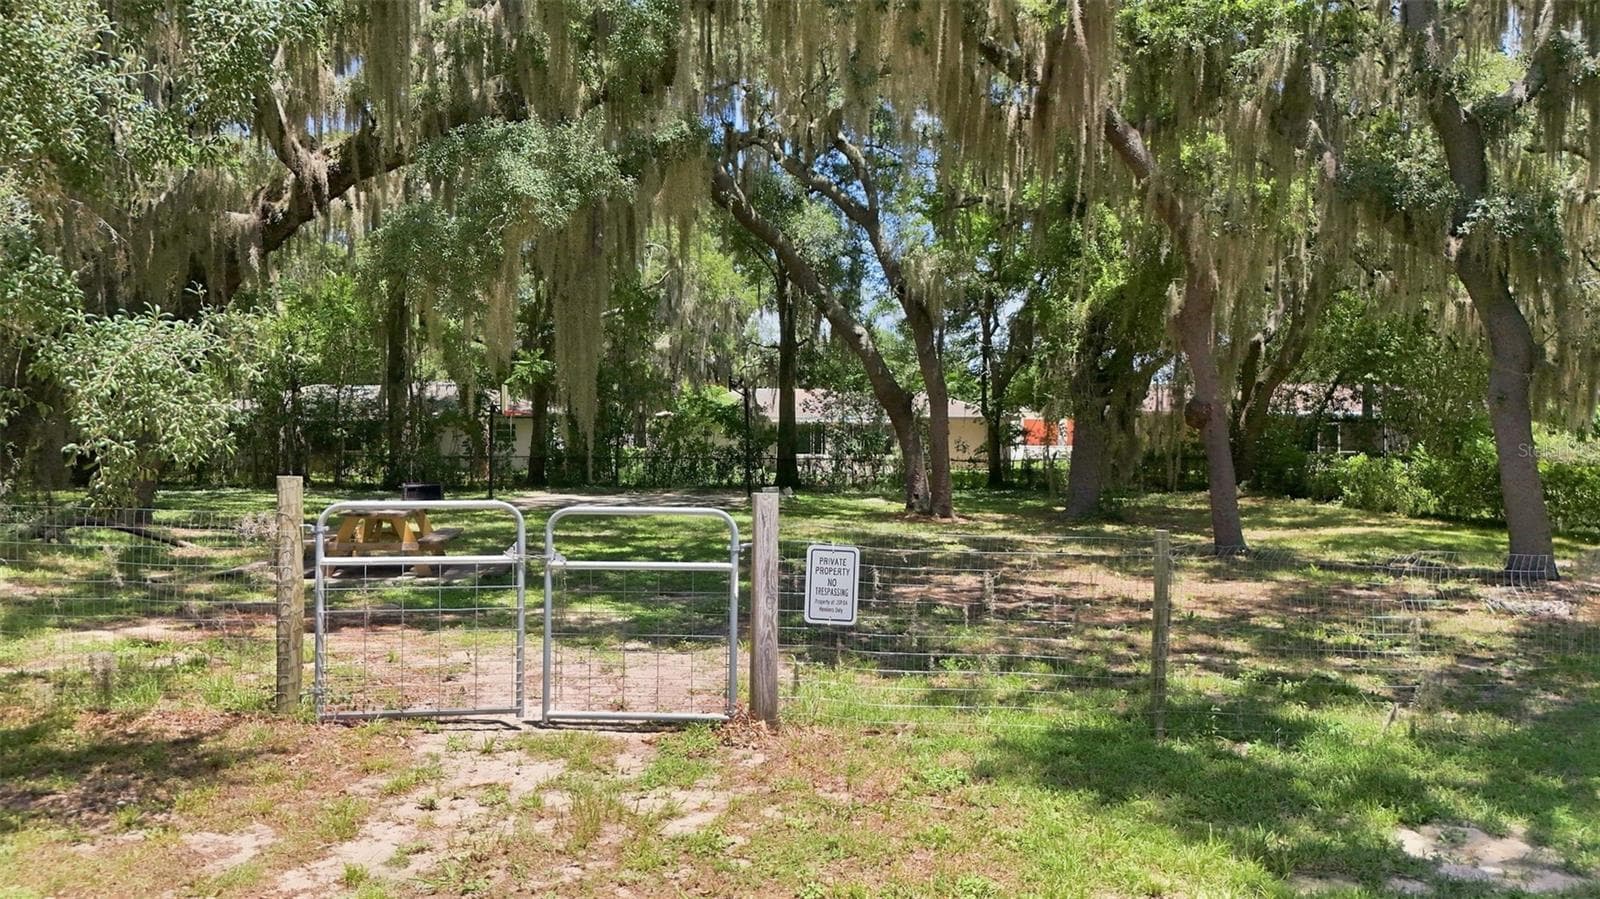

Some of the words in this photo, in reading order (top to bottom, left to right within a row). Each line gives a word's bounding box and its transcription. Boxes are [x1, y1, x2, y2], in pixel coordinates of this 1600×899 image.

[819, 557, 847, 566] PRIVATE
[815, 567, 850, 576] PROPERTY
[827, 578, 837, 587] NO
[815, 587, 848, 597] TRESPASSING
